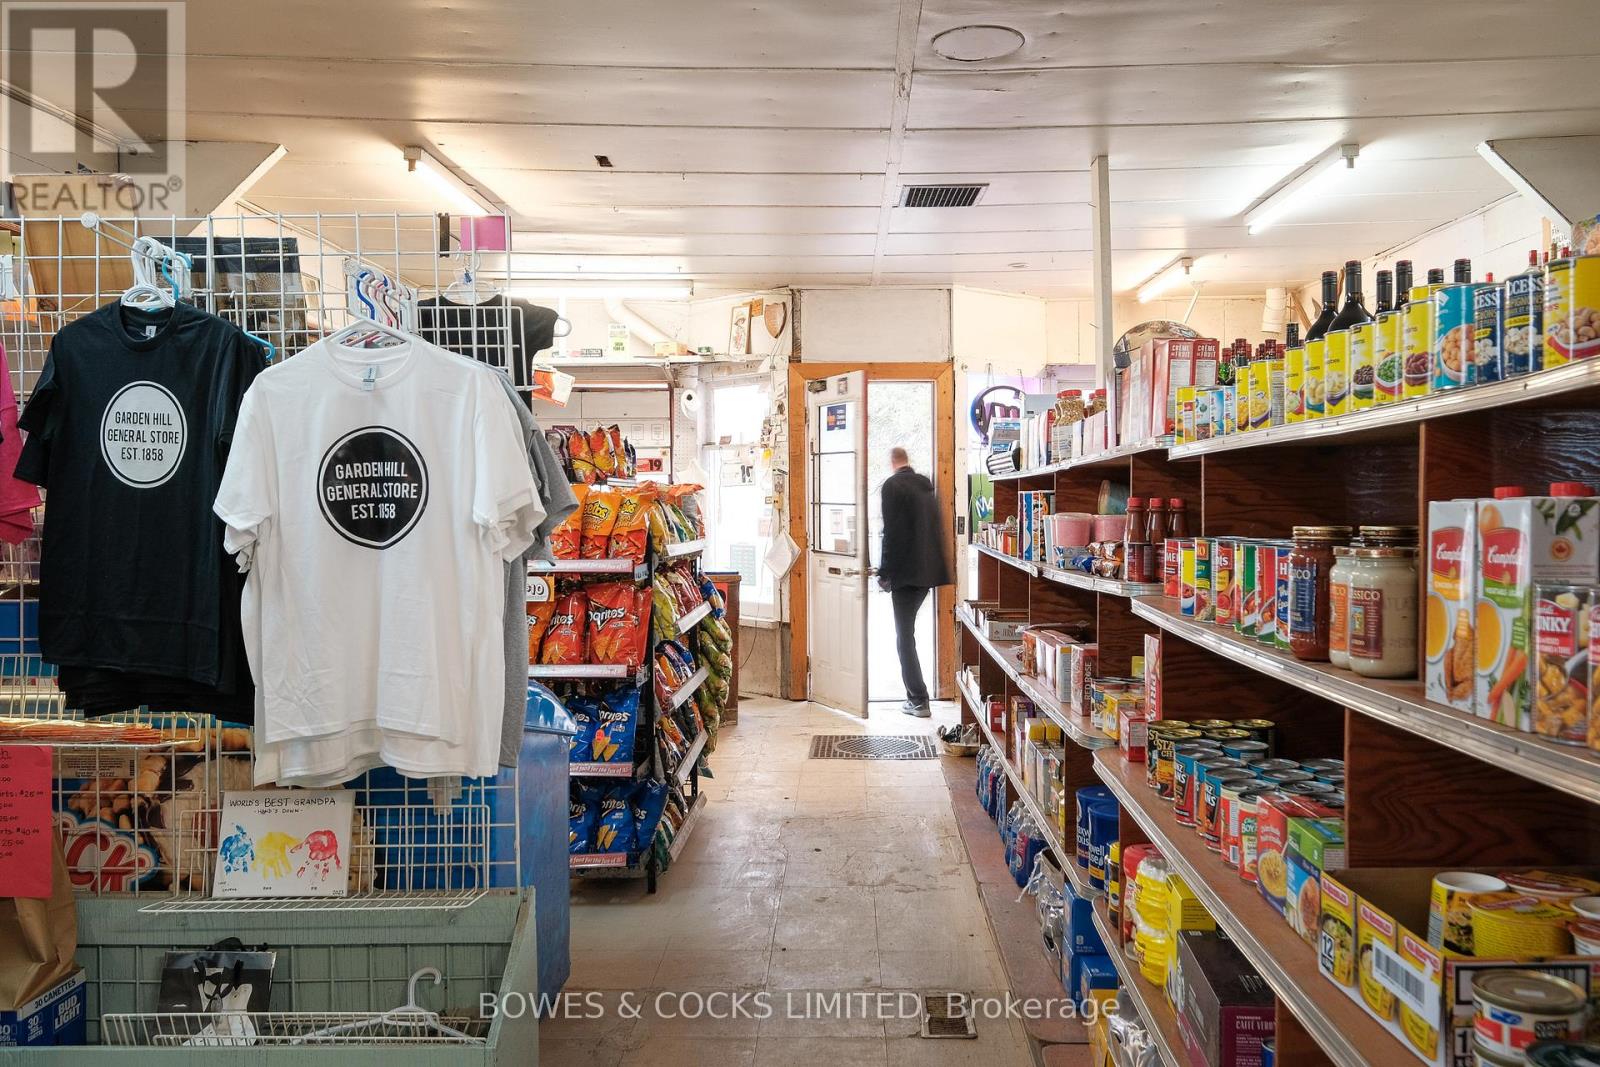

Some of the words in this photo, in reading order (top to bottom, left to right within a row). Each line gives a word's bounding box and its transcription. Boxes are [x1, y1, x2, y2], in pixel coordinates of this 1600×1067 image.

[115, 411, 150, 425] GARDEN
[153, 413, 173, 426] HILL
[107, 428, 147, 443] GENERAL
[150, 430, 180, 444] STORE
[335, 461, 384, 479] GARDEN
[384, 461, 408, 477] HILL
[326, 483, 382, 501] GENERAL
[383, 482, 418, 499] STORE
[229, 799, 260, 807] WORLD'S
[264, 797, 290, 808] BEST
[293, 797, 336, 806] GRANDPA
[58, 995, 78, 1016] BUD
[54, 1003, 81, 1030] LIGHT
